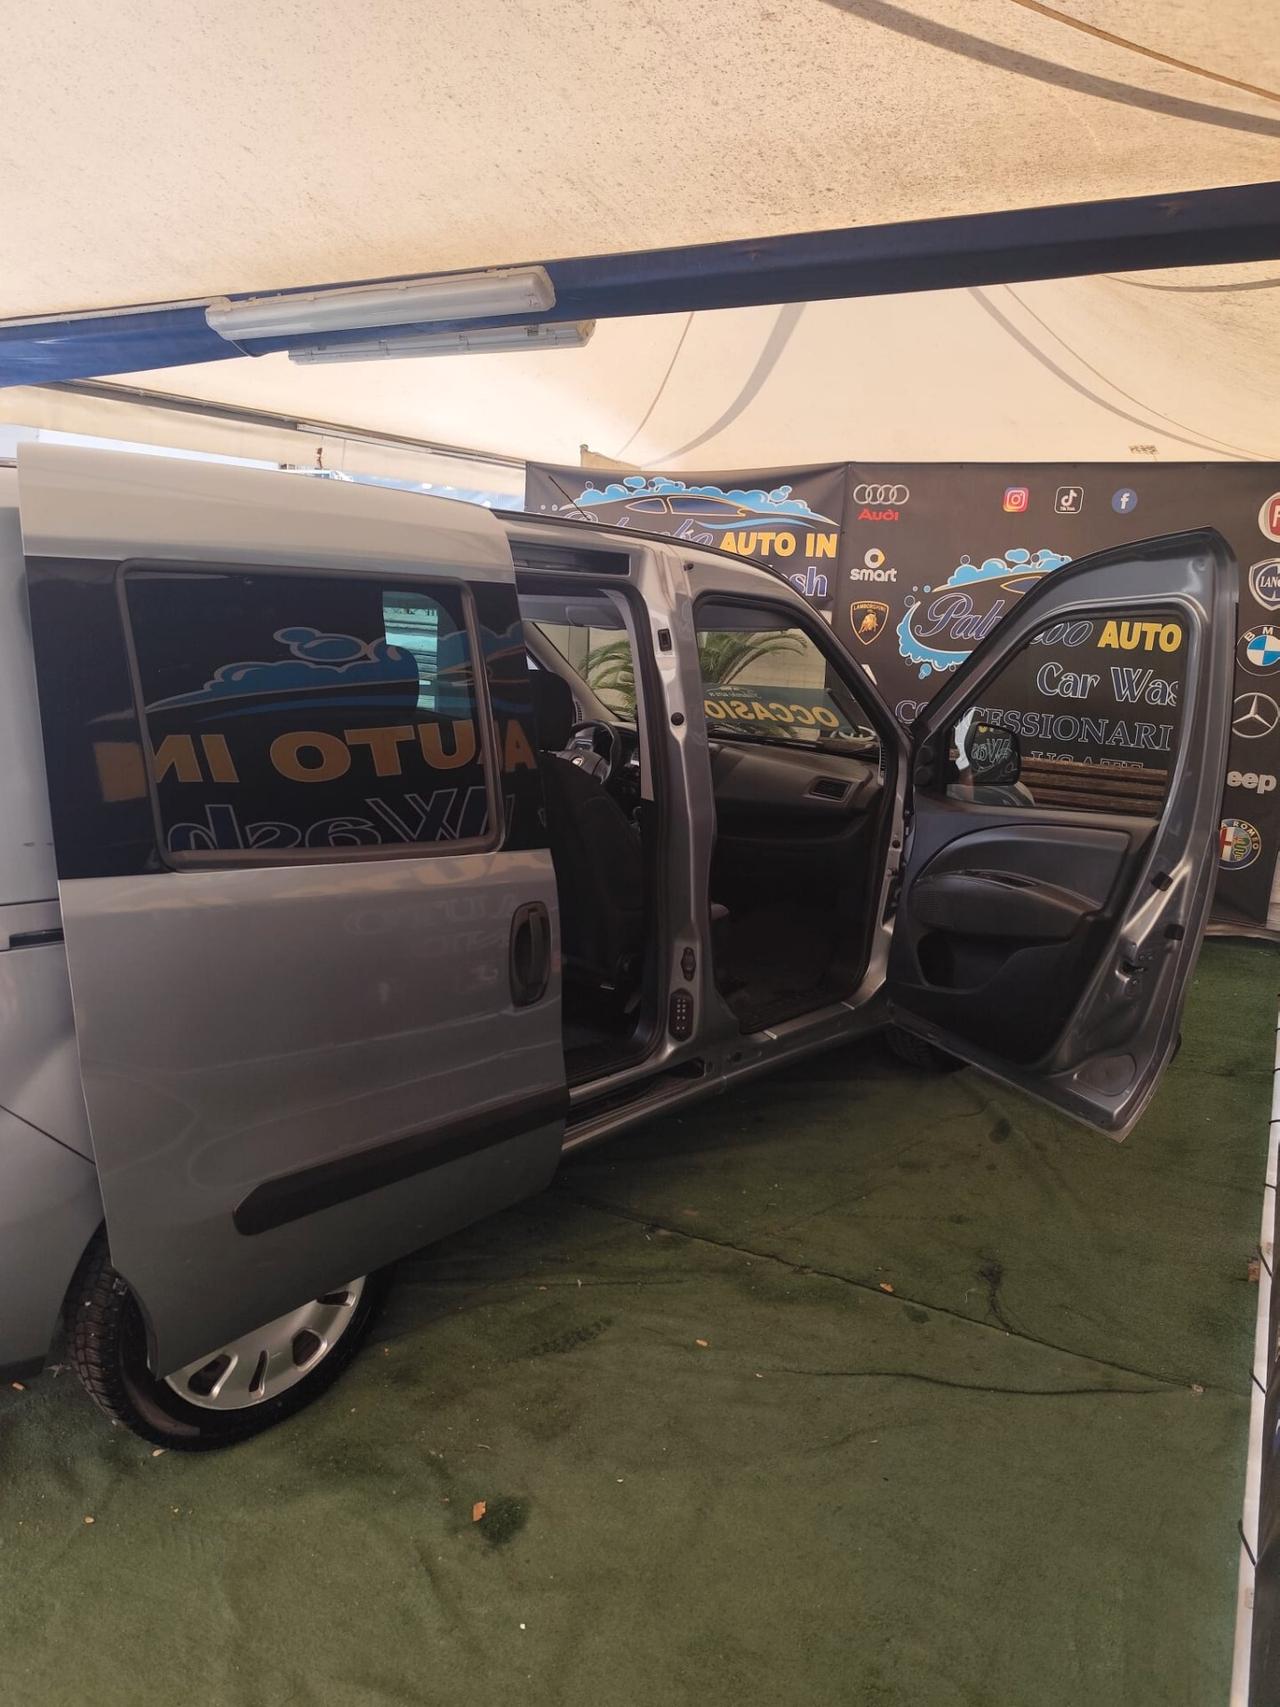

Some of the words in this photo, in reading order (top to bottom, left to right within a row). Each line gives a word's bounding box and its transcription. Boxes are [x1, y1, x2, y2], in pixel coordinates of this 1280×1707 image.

[858, 508, 899, 521] Audi
[720, 532, 796, 557] AUTO
[805, 533, 838, 558] IN
[788, 565, 828, 597] sh
[850, 567, 898, 582] smart
[1097, 620, 1183, 653] AUTO
[1244, 626, 1274, 642] BM
[1037, 661, 1100, 699] Car
[1111, 666, 1179, 707] Was
[1227, 770, 1277, 795] eep
